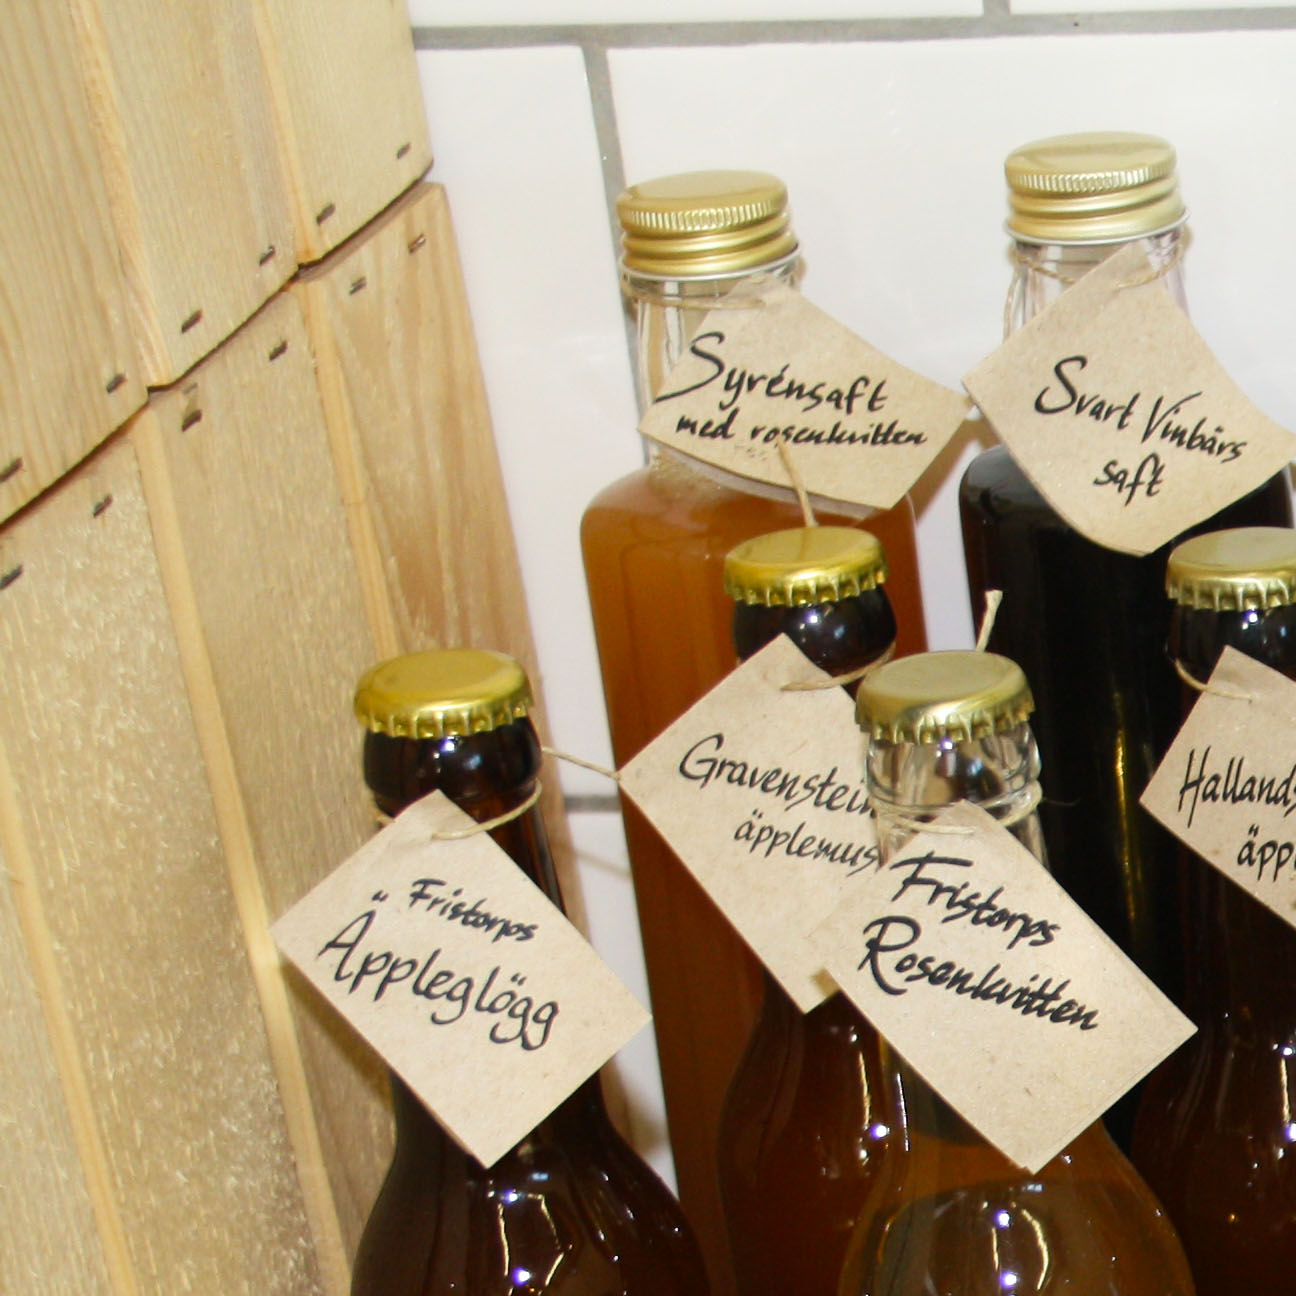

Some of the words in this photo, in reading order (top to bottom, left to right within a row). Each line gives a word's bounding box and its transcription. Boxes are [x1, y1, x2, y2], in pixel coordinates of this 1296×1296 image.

[654, 331, 888, 414] Syrénsaft
[1036, 356, 1139, 431] Svart
[676, 415, 733, 440] med
[1094, 453, 1163, 506] saft
[734, 809, 879, 877] äpplemus
[891, 852, 1062, 949] Fristorps
[318, 890, 559, 1051] Äppleglögg
[858, 916, 1098, 1031] Rosenkvitten
